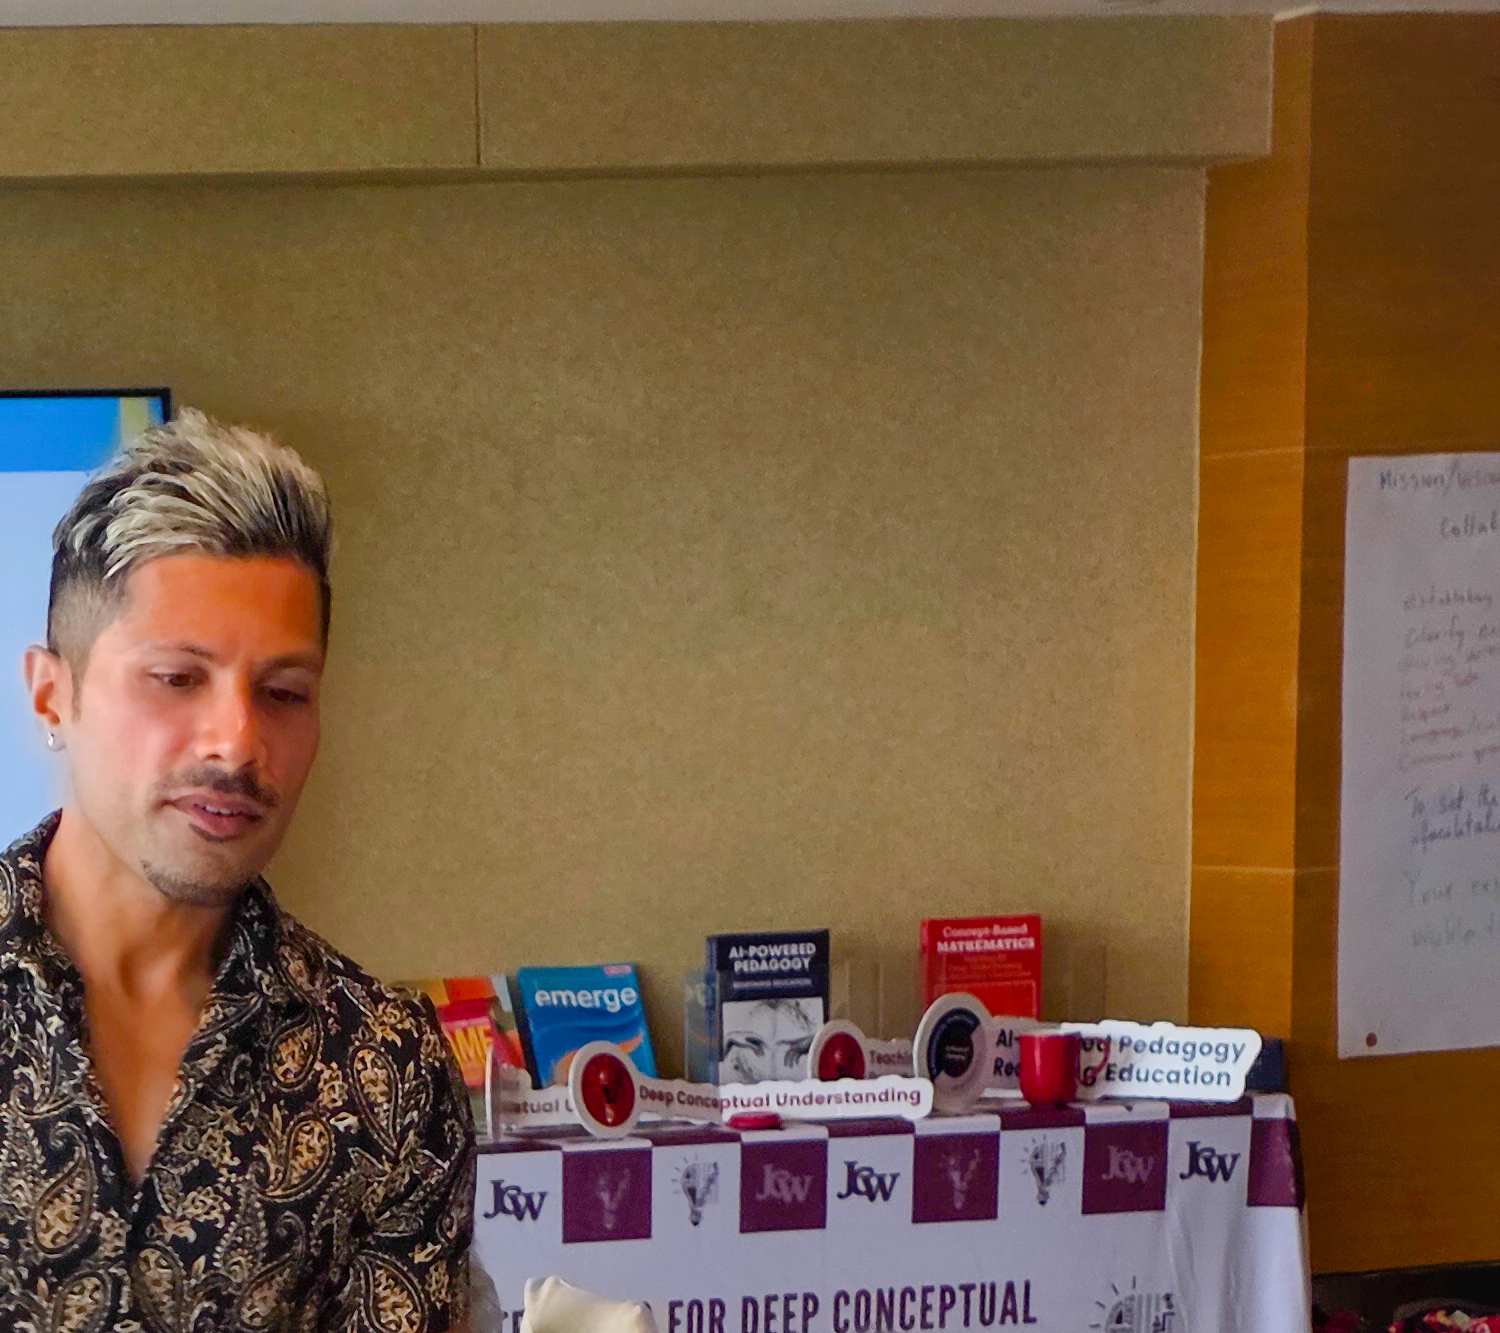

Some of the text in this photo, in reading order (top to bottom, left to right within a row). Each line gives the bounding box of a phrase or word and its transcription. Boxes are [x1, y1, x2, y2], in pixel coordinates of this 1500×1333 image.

[729, 942, 816, 959] AI-POWERED
[936, 937, 1035, 953] MATHEMATICS
[734, 957, 810, 973] PEDAGOGY
[534, 986, 637, 1013] emerge
[1118, 1034, 1246, 1064] Pedagogy
[1105, 1063, 1231, 1087] Education
[639, 1084, 921, 1112] Deep Conceptual Understanding
